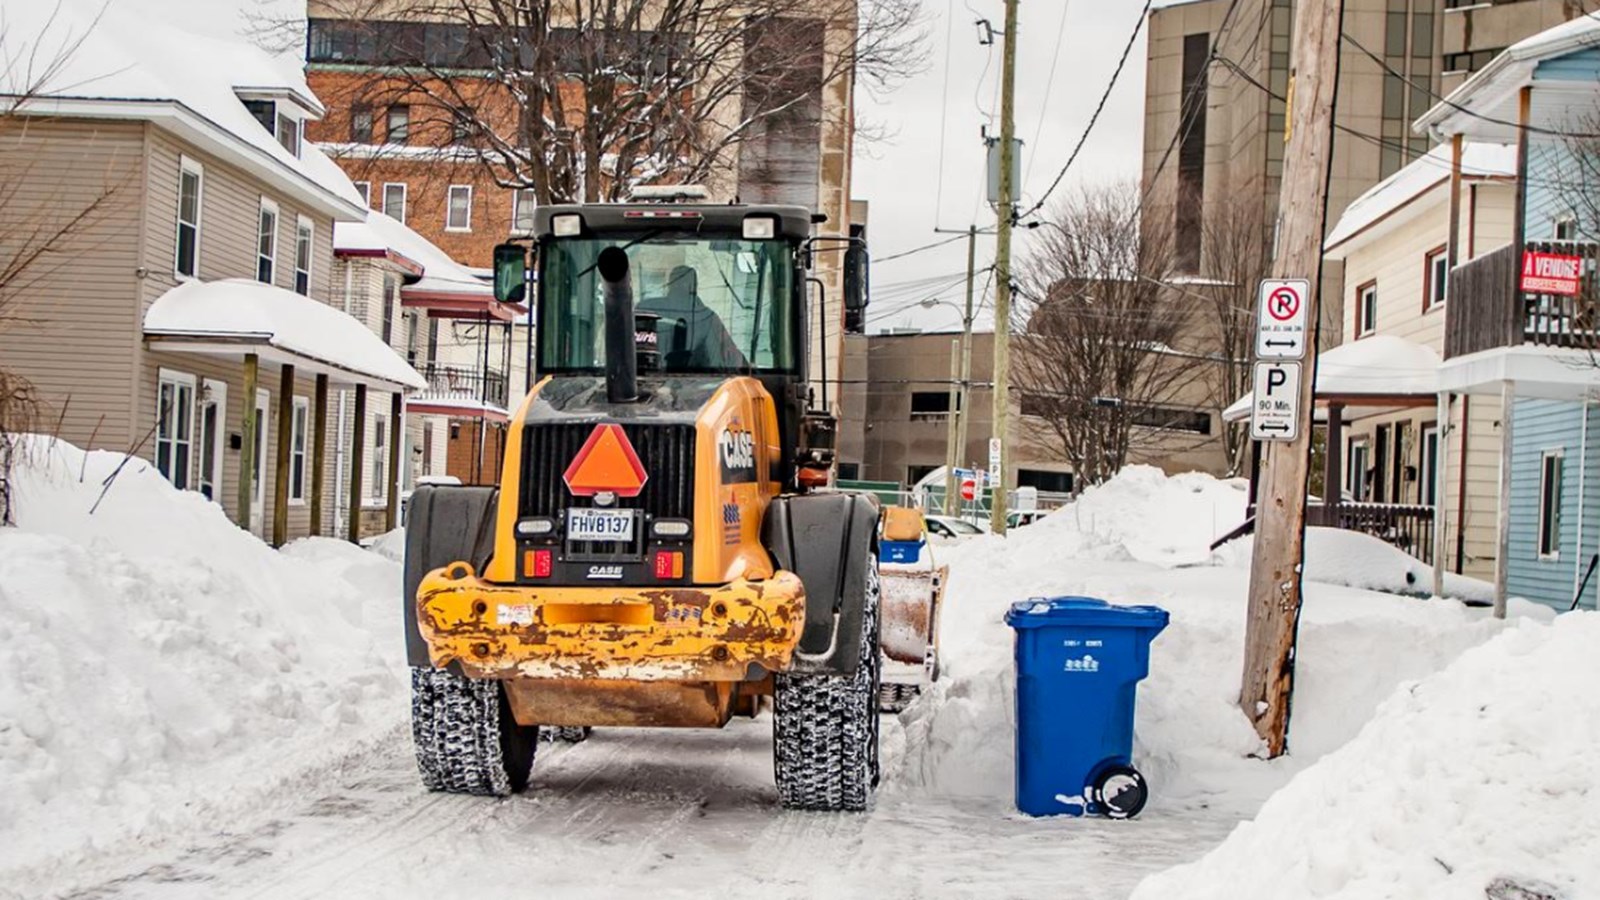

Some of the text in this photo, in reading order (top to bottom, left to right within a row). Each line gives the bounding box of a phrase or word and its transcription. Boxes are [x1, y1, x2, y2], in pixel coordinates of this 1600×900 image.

[1536, 257, 1579, 278] VENDRE
[1267, 369, 1286, 396] P
[1259, 400, 1291, 411] 90 Min.
[723, 429, 753, 468] CASE
[570, 516, 630, 533] FHV8137
[589, 565, 623, 575] CASE
